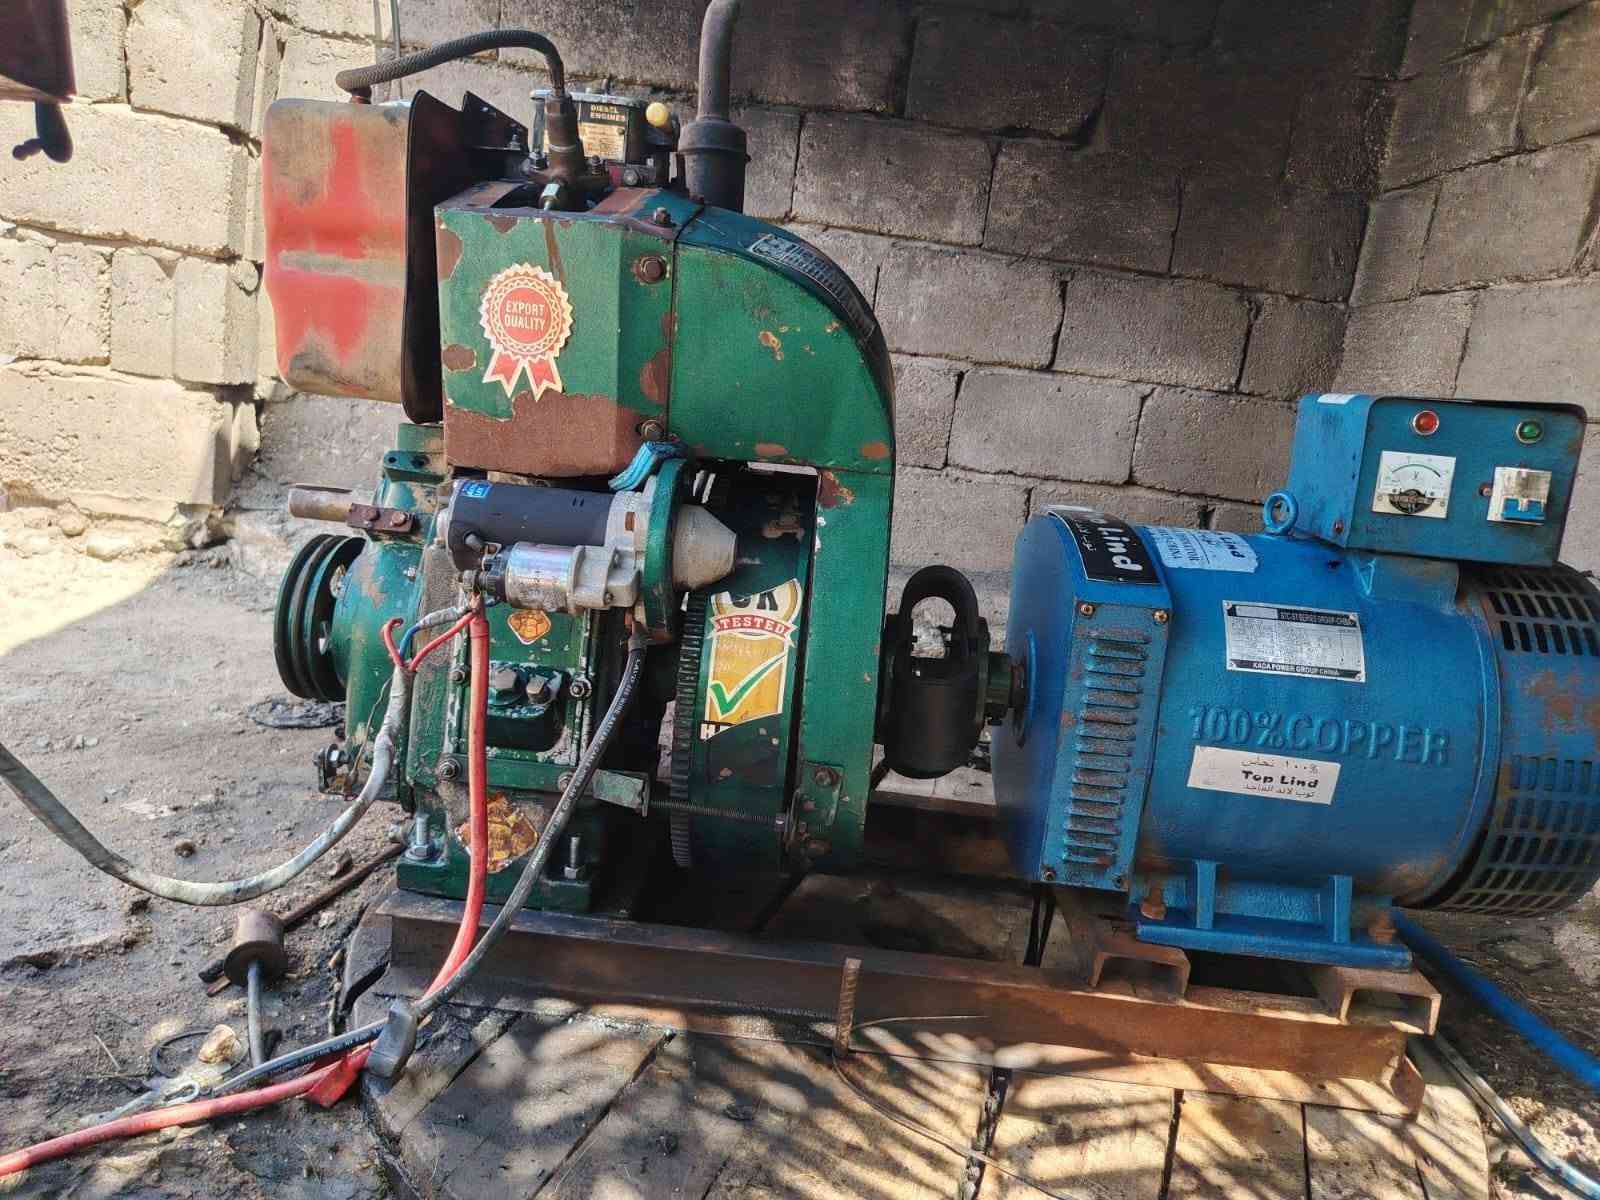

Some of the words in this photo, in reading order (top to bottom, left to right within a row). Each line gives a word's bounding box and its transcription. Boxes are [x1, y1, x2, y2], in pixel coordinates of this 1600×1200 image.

[590, 104, 617, 113] DIESEL
[590, 112, 625, 121] ENGINES
[505, 300, 545, 316] EXPORT
[504, 314, 546, 330] QUALITY
[1097, 527, 1143, 571] Lind
[720, 616, 785, 634] TESTED
[1271, 664, 1295, 672] POWER
[1295, 666, 1319, 674] GROUP
[1319, 668, 1340, 676] CHINA
[1241, 770, 1274, 784] Top
[1280, 775, 1319, 788] Lind
